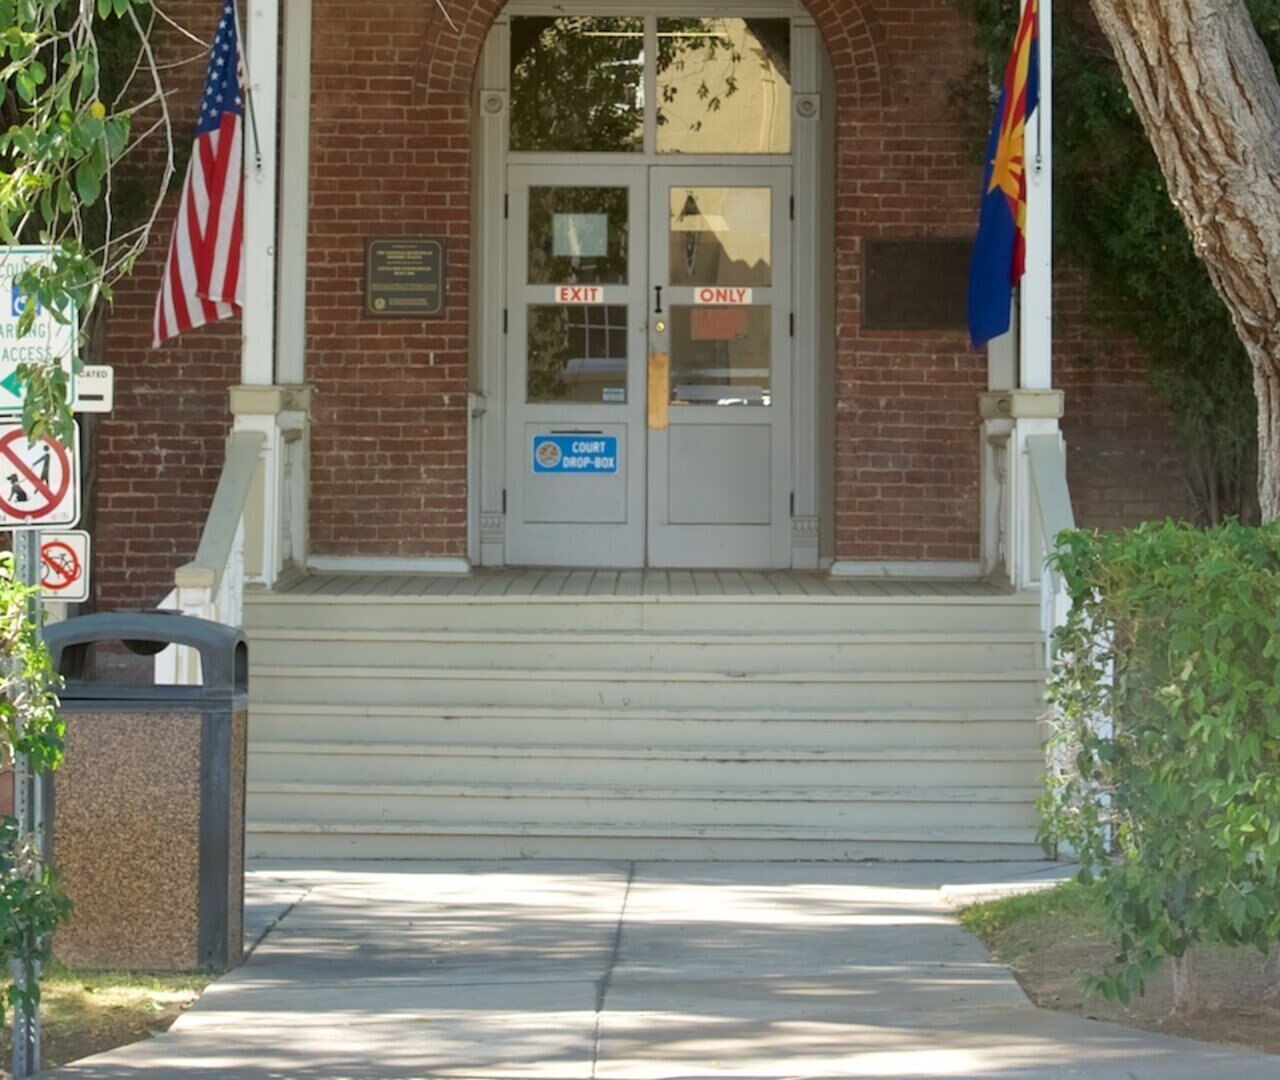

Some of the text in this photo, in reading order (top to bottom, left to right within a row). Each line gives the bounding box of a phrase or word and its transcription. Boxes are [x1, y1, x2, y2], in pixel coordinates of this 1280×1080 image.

[560, 287, 598, 301] EXIT
[700, 288, 746, 302] ONLY
[1, 346, 53, 362] ACCESS
[79, 370, 108, 378] CATED
[572, 441, 606, 453] COURT
[562, 456, 615, 469] DROP-BOX
